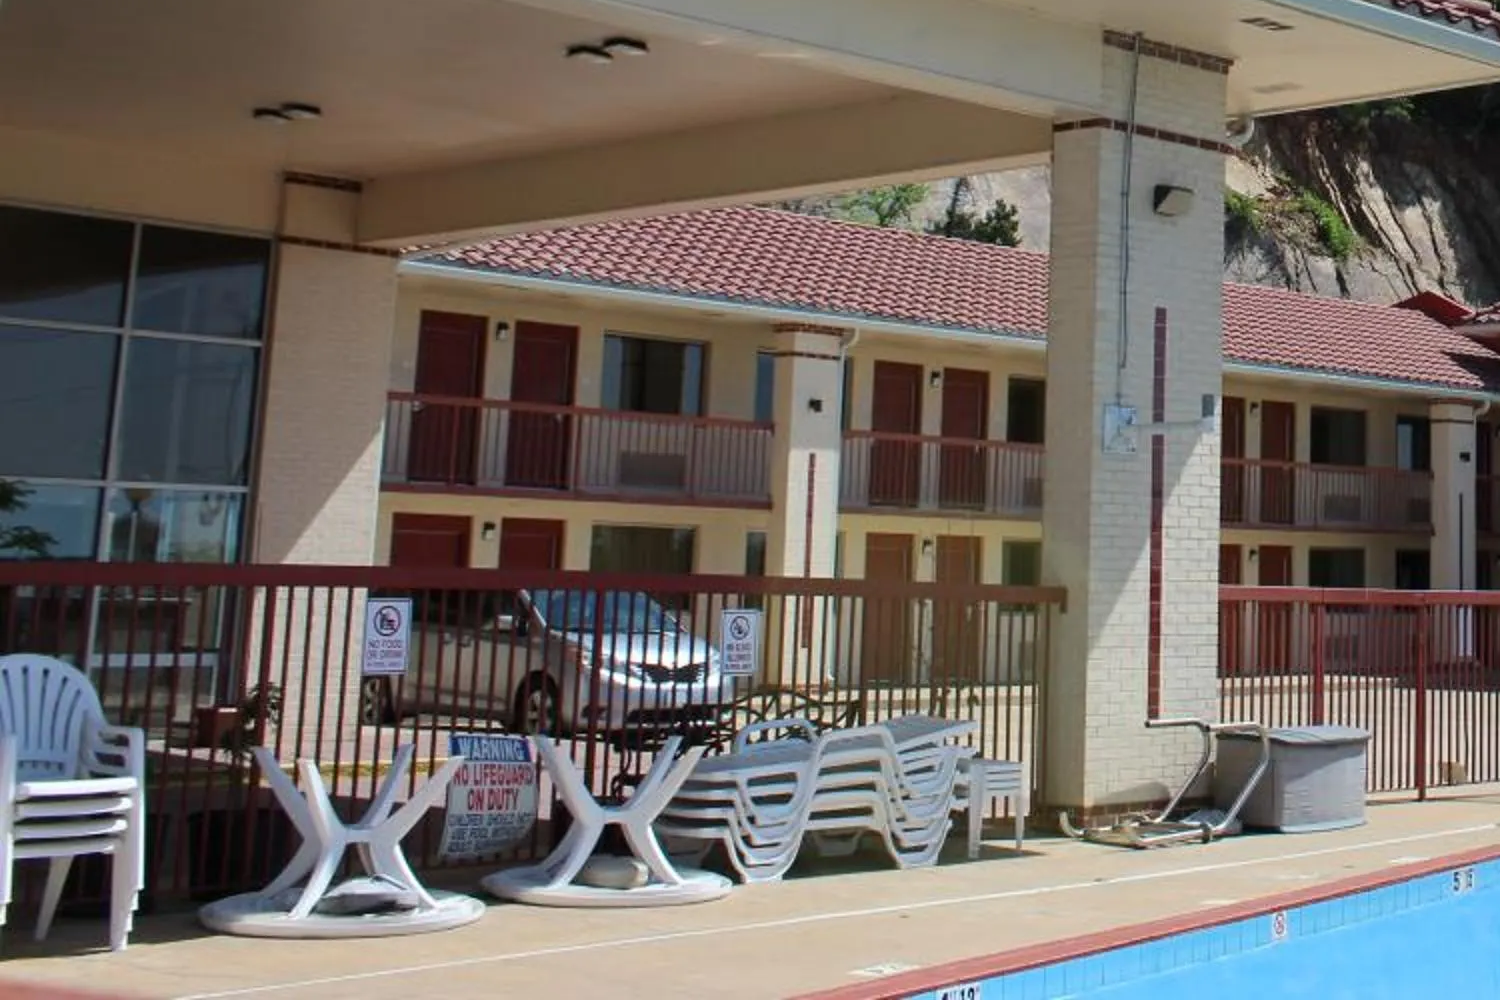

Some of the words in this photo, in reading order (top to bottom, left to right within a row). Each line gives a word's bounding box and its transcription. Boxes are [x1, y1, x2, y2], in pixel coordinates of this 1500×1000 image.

[458, 737, 525, 760] WARNING
[474, 764, 534, 786] LIFEGUARD
[467, 788, 485, 812] ON
[487, 788, 519, 812] DUTY
